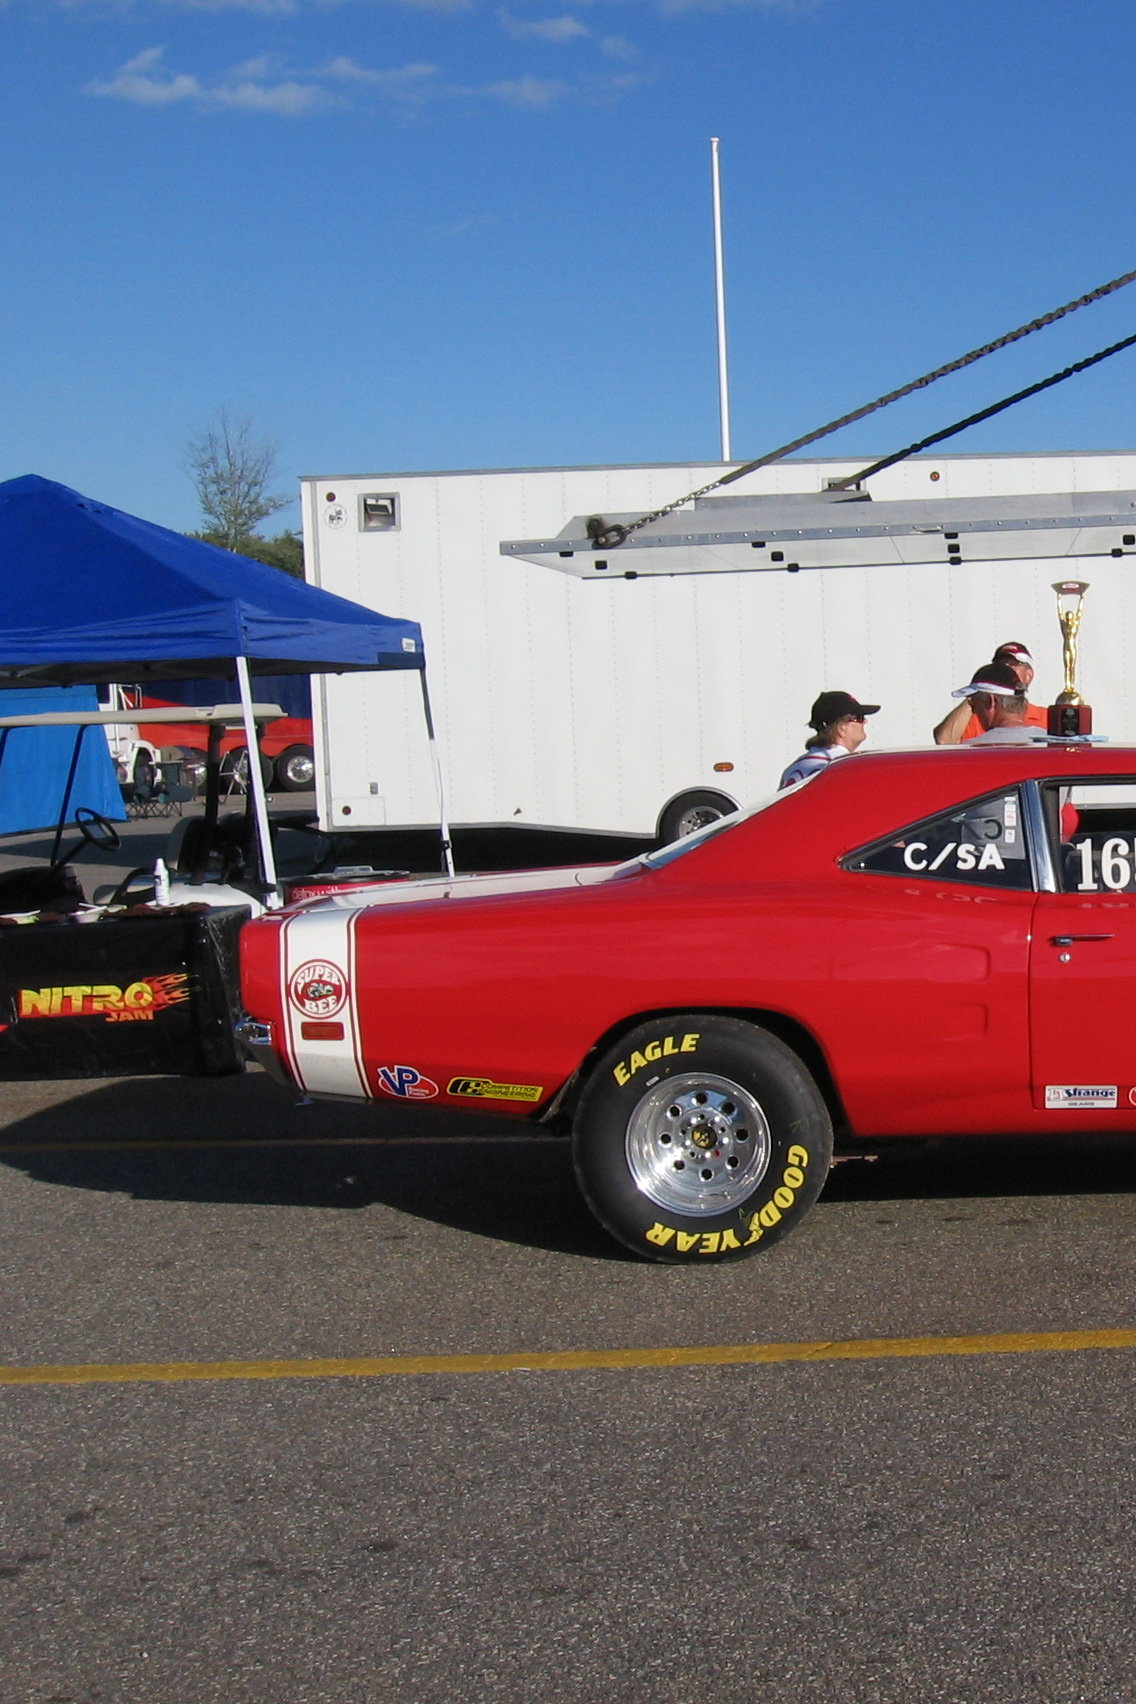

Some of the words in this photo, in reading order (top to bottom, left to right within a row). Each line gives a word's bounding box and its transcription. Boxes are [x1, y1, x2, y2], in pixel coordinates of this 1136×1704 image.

[904, 842, 1006, 872] C/SA
[297, 965, 340, 992] SUPER
[20, 981, 154, 1017] NITRO
[303, 995, 337, 1014] BEE
[105, 1010, 155, 1023] JAM
[612, 1033, 700, 1087] EAGLE
[378, 1065, 421, 1097] VP
[645, 1144, 809, 1254] GOODYEAR
